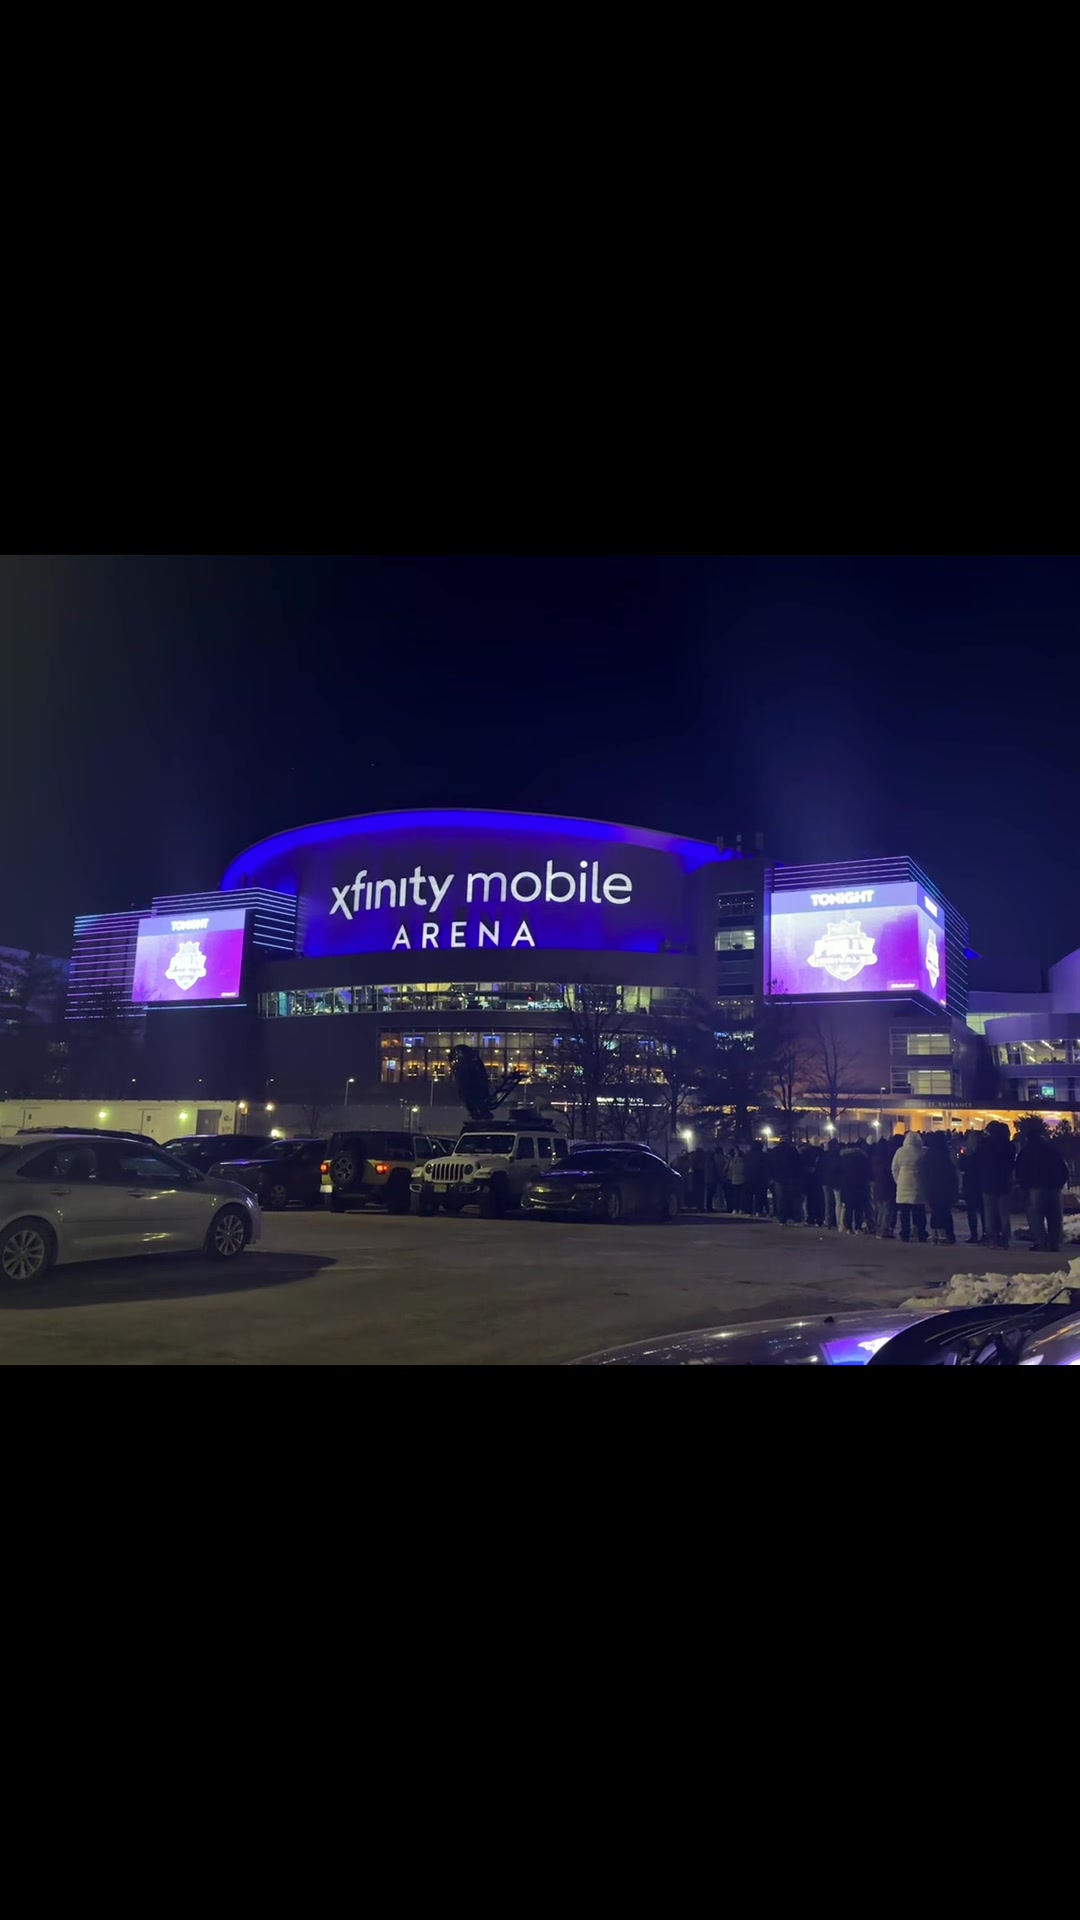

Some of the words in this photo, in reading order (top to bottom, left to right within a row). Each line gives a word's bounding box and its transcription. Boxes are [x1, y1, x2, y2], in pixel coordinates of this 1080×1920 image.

[329, 866, 455, 920] xfinity
[467, 860, 633, 905] mobile
[810, 890, 875, 906] TONIGHT
[391, 920, 536, 950] ARENA
